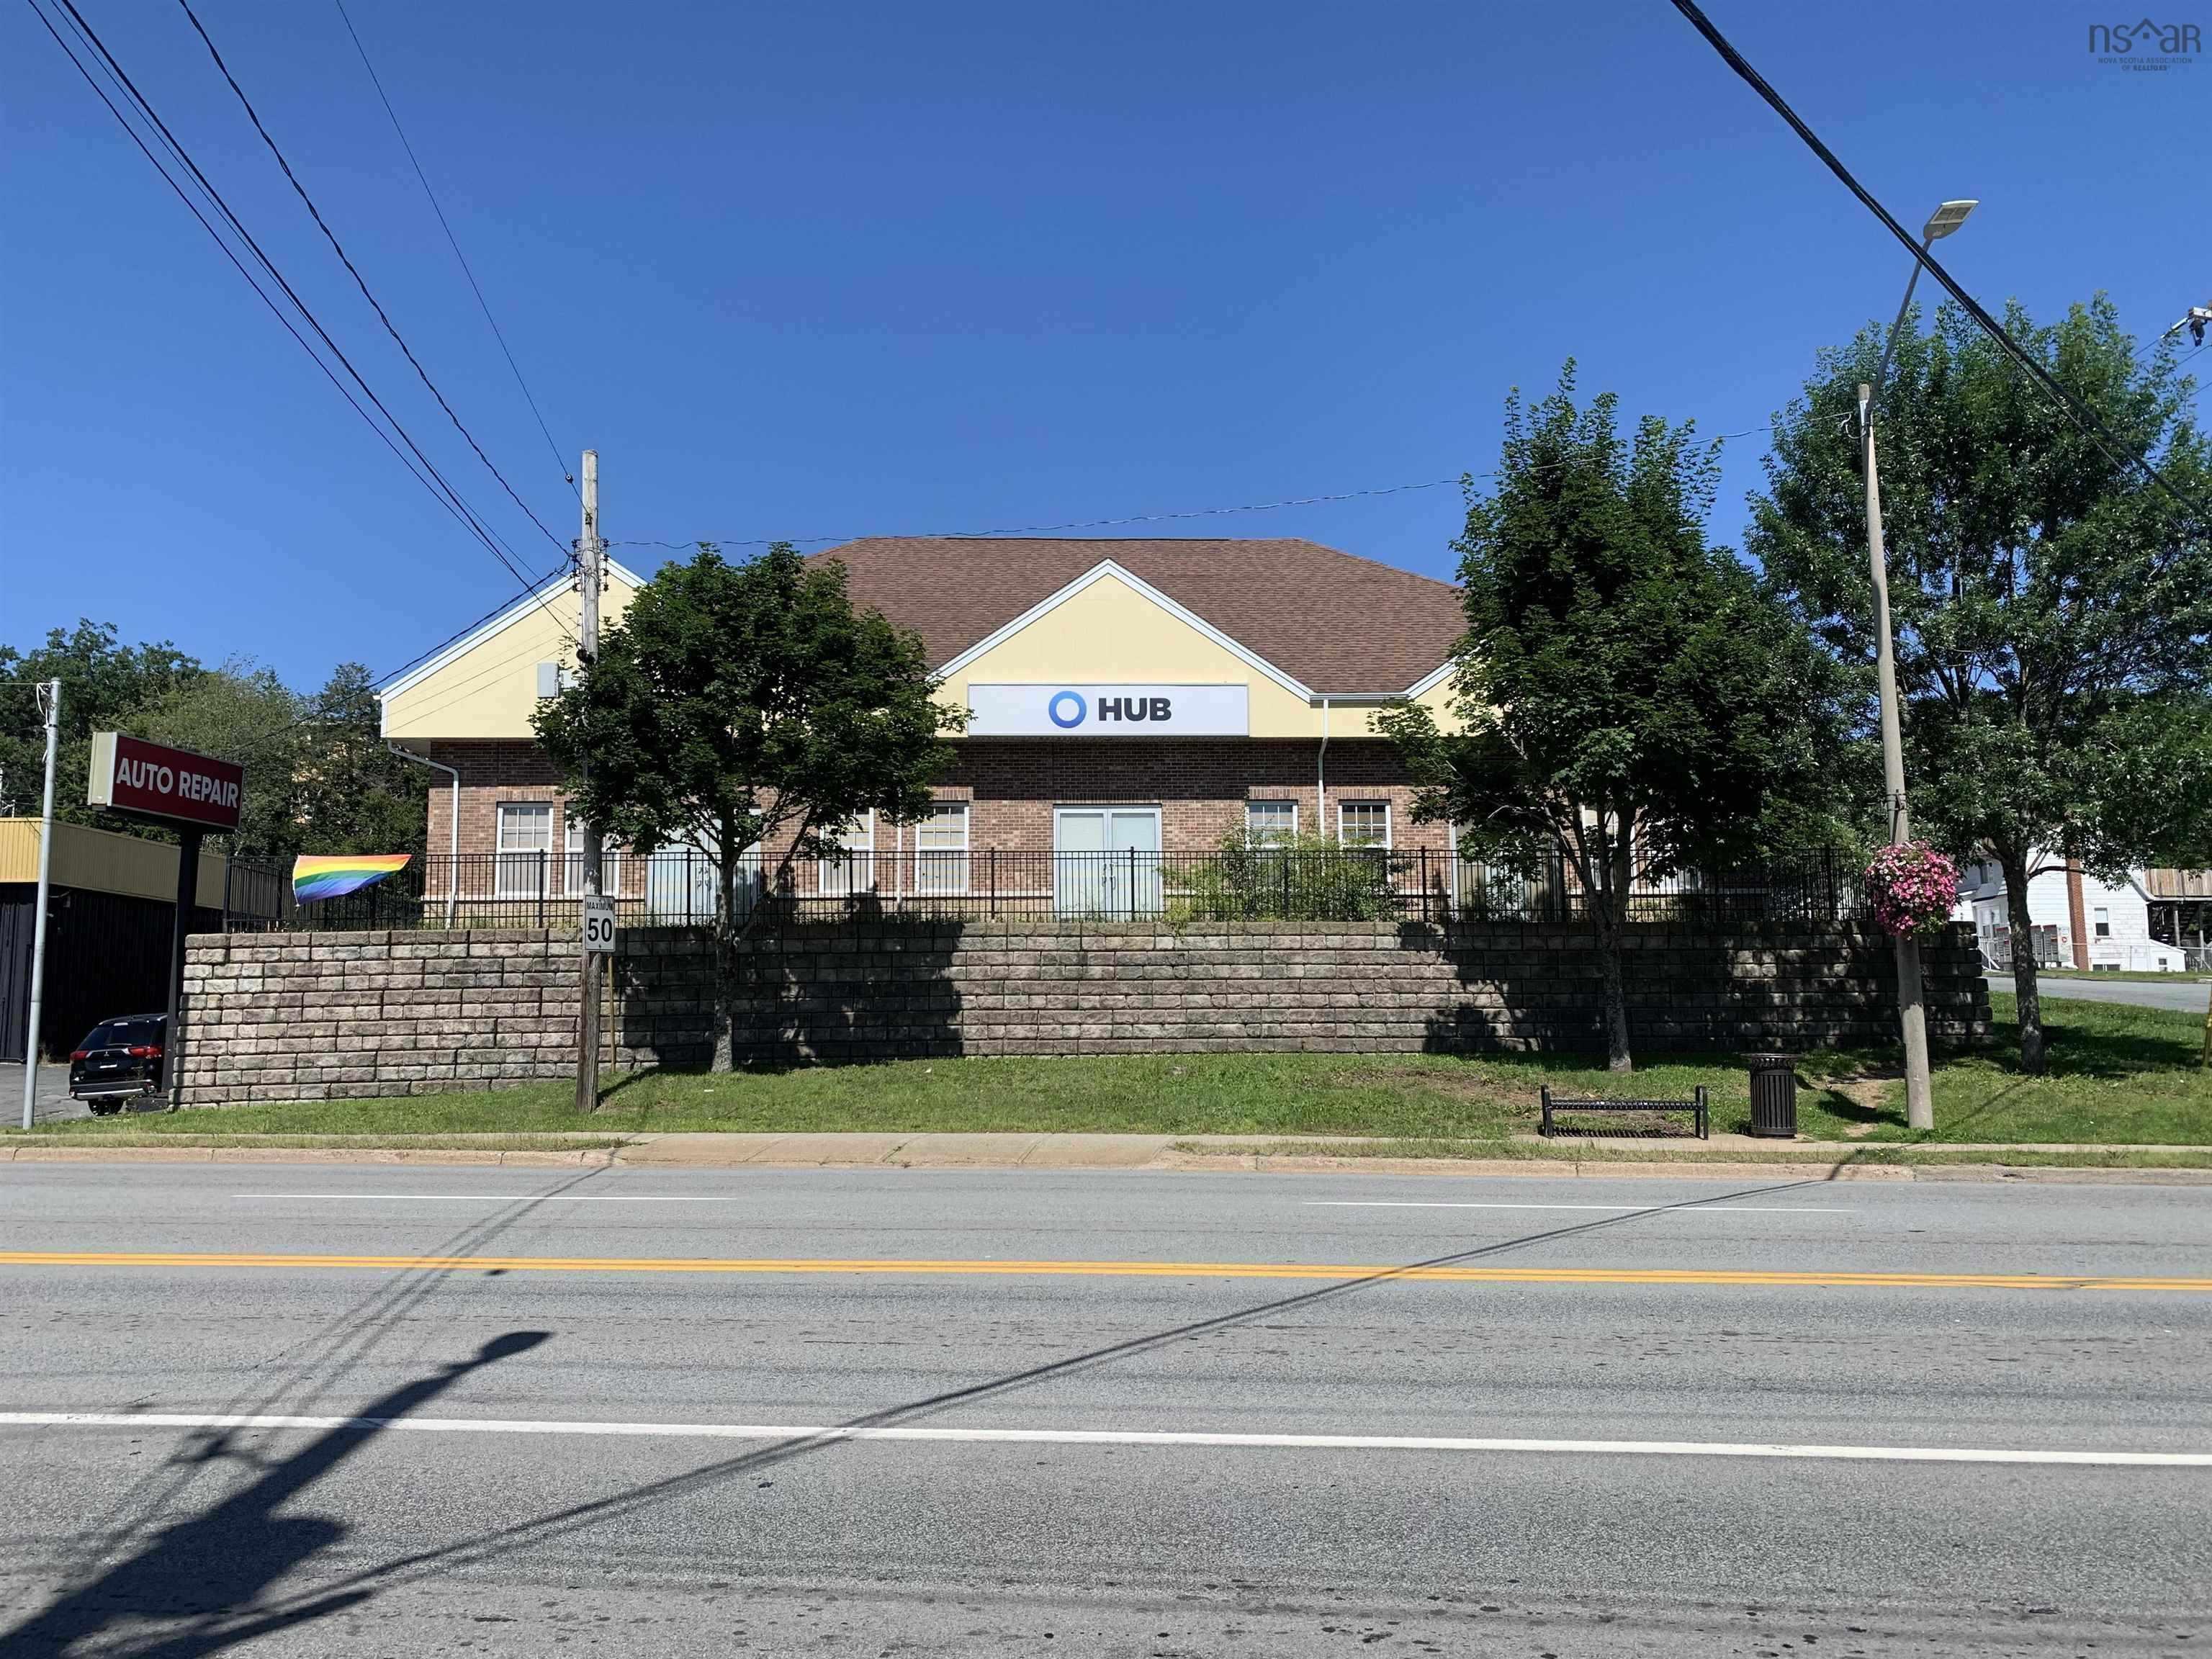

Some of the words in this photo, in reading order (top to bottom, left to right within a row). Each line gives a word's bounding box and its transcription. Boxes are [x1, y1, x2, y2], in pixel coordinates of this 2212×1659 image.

[1098, 697, 1172, 721] HUB
[116, 757, 174, 793] AUTO
[178, 770, 240, 809] REPAIR
[587, 901, 613, 911] MAXIMUM
[587, 917, 613, 943] 50
